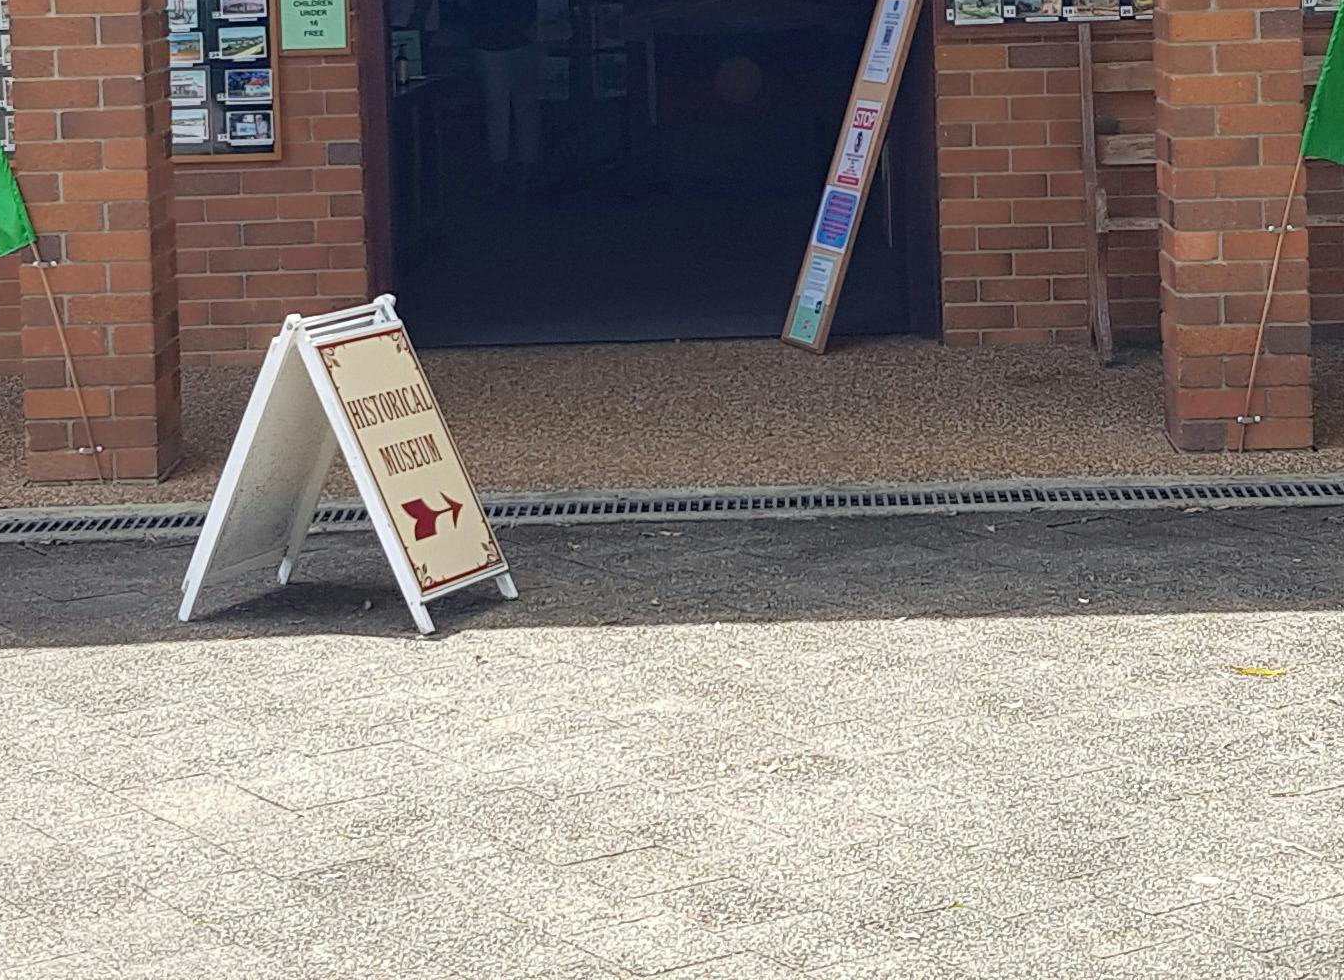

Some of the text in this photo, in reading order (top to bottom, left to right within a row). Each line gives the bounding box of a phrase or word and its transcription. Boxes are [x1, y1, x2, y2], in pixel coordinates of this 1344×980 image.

[292, 0, 334, 8] CHILDREN
[299, 9, 328, 17] UNDER
[854, 110, 877, 128] STOP
[346, 382, 433, 430] HISTORICAL
[378, 433, 443, 477] MUSEUM
